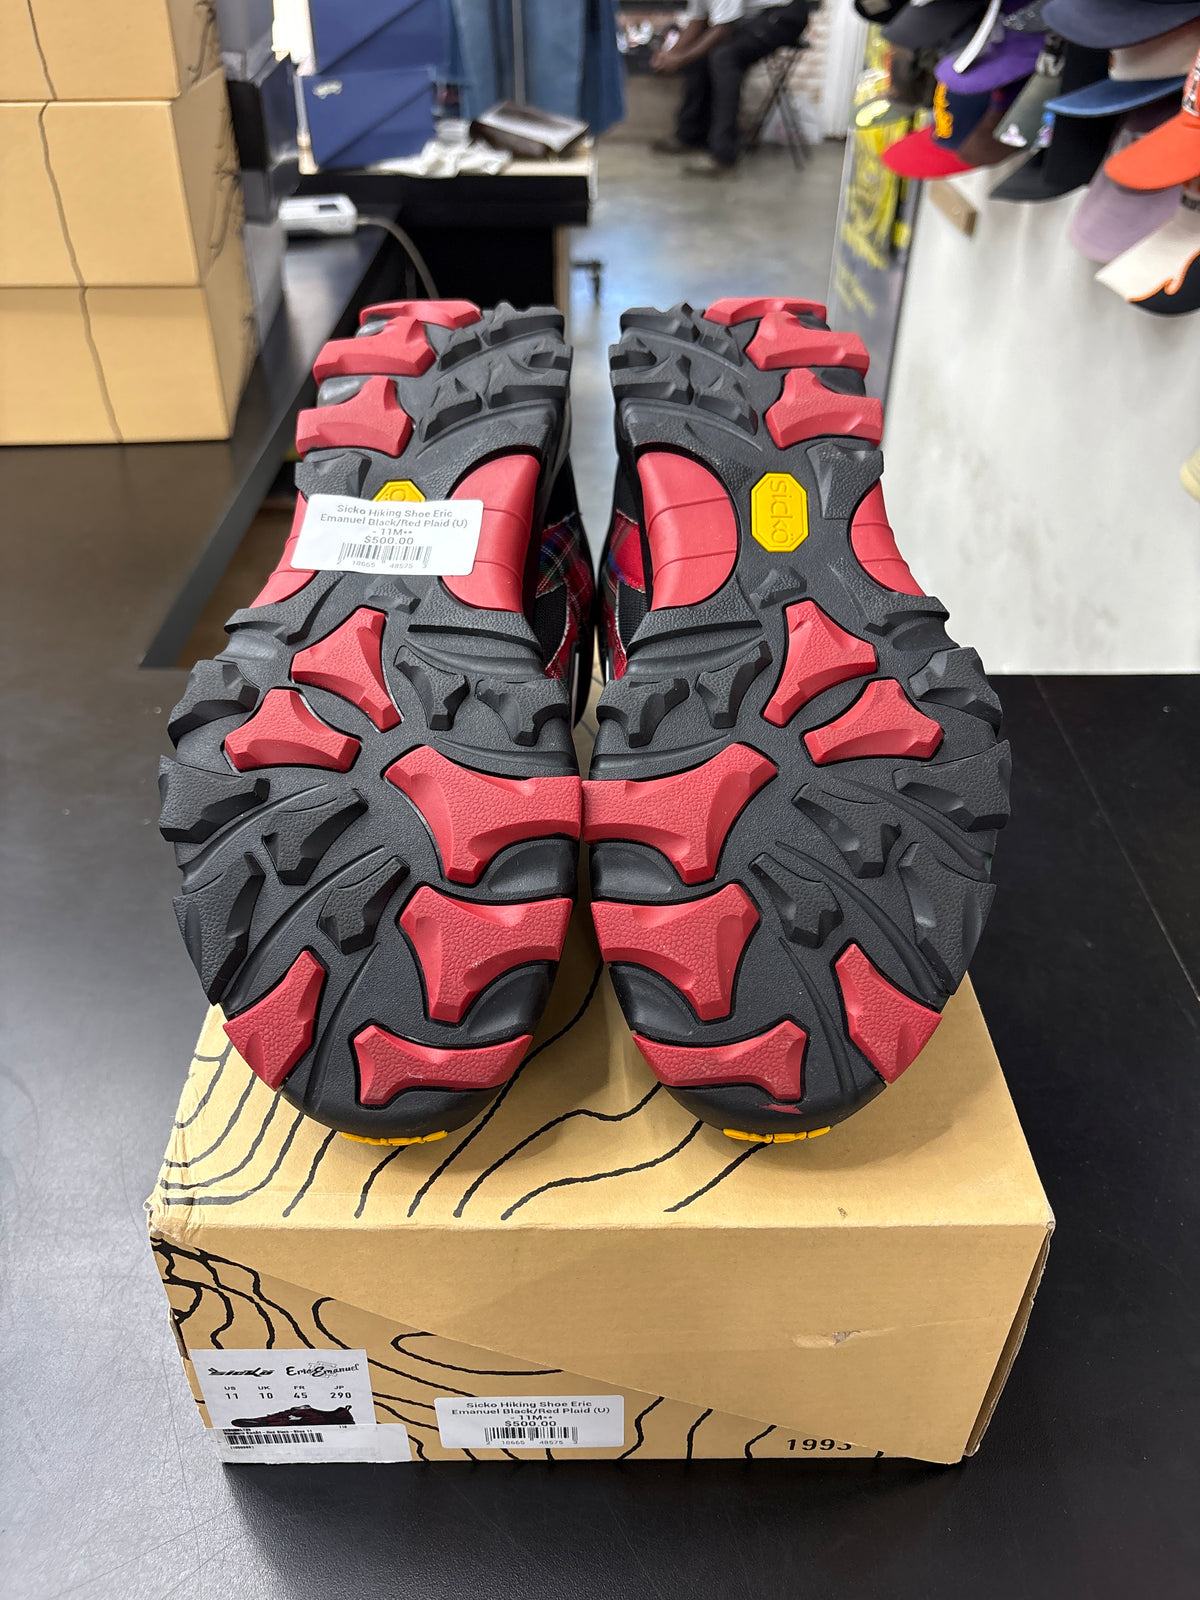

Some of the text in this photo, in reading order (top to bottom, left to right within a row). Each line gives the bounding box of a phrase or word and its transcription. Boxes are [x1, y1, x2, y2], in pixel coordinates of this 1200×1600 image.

[337, 505, 366, 515] Sicko
[369, 509, 401, 518] Hiking
[434, 509, 452, 518] Eric
[321, 514, 365, 525] Emanuel
[452, 520, 468, 528] (U)
[364, 536, 414, 545] $500.00
[311, 1363, 360, 1378] Emanuel
